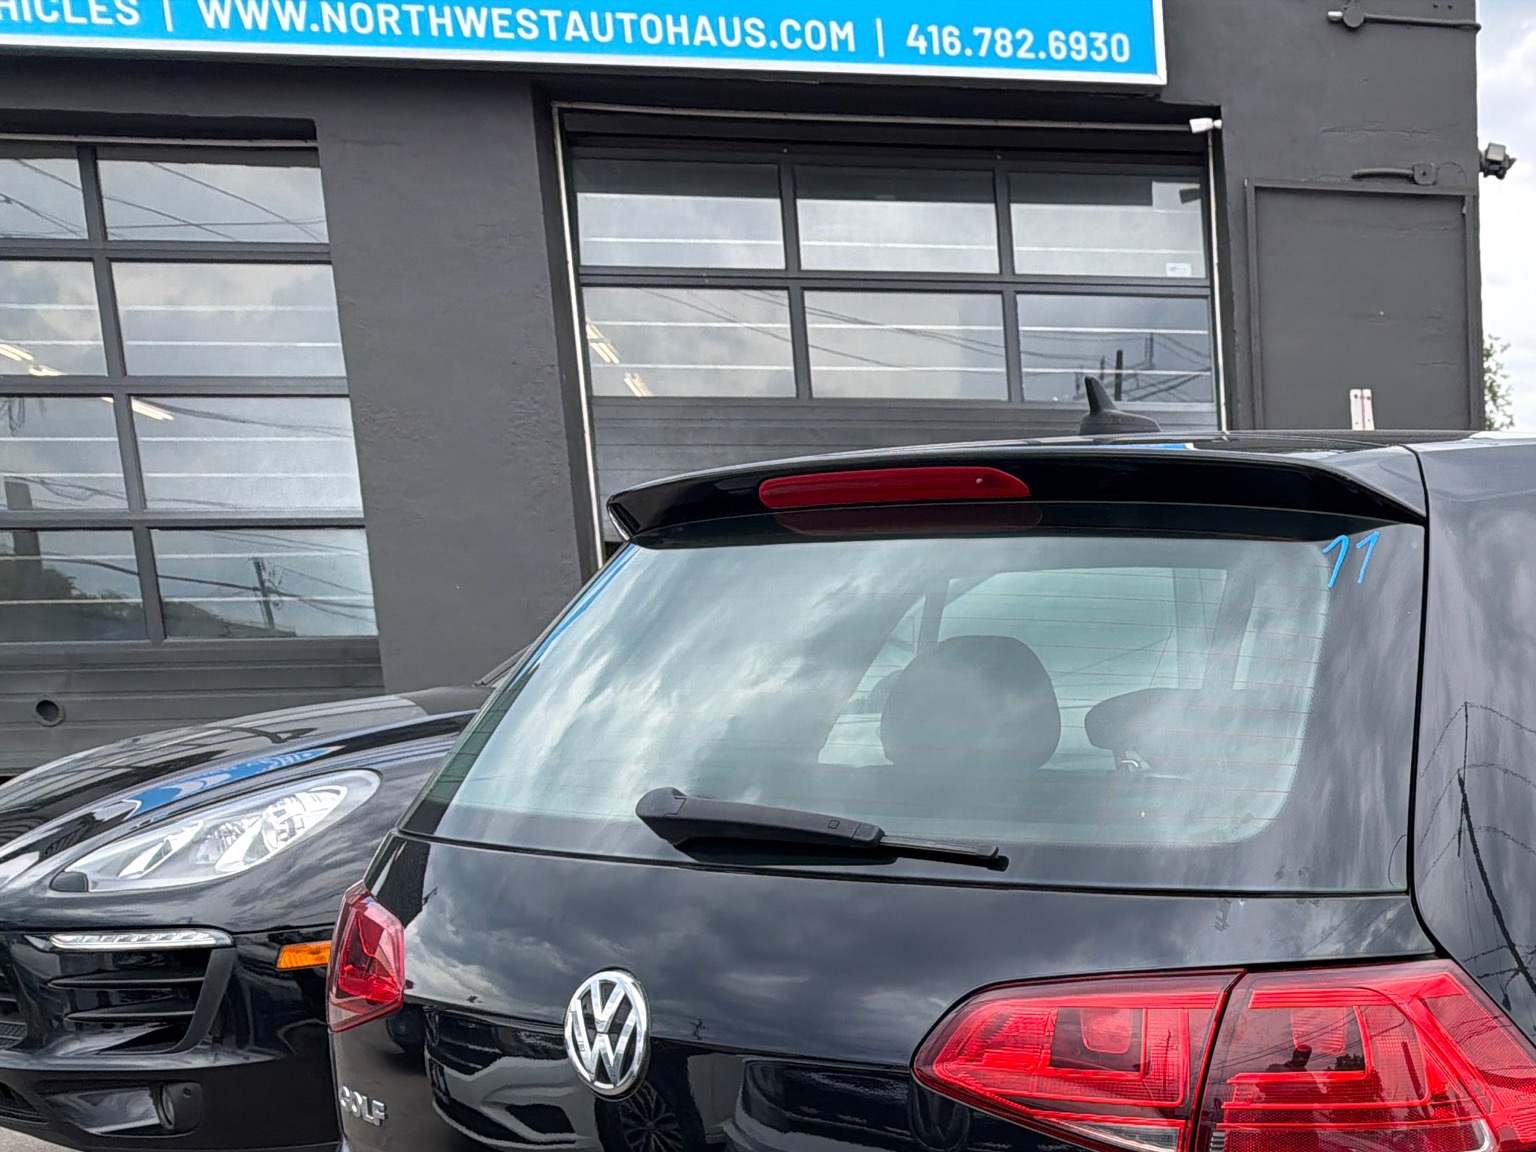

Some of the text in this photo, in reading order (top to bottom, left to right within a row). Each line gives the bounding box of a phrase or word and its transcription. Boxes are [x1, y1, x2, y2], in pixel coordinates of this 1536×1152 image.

[198, 0, 855, 52] WWW.NORTHWESTAUTOHAUS.COM
[906, 24, 1130, 62] 416.782.6930
[340, 1085, 385, 1126] GOLF
